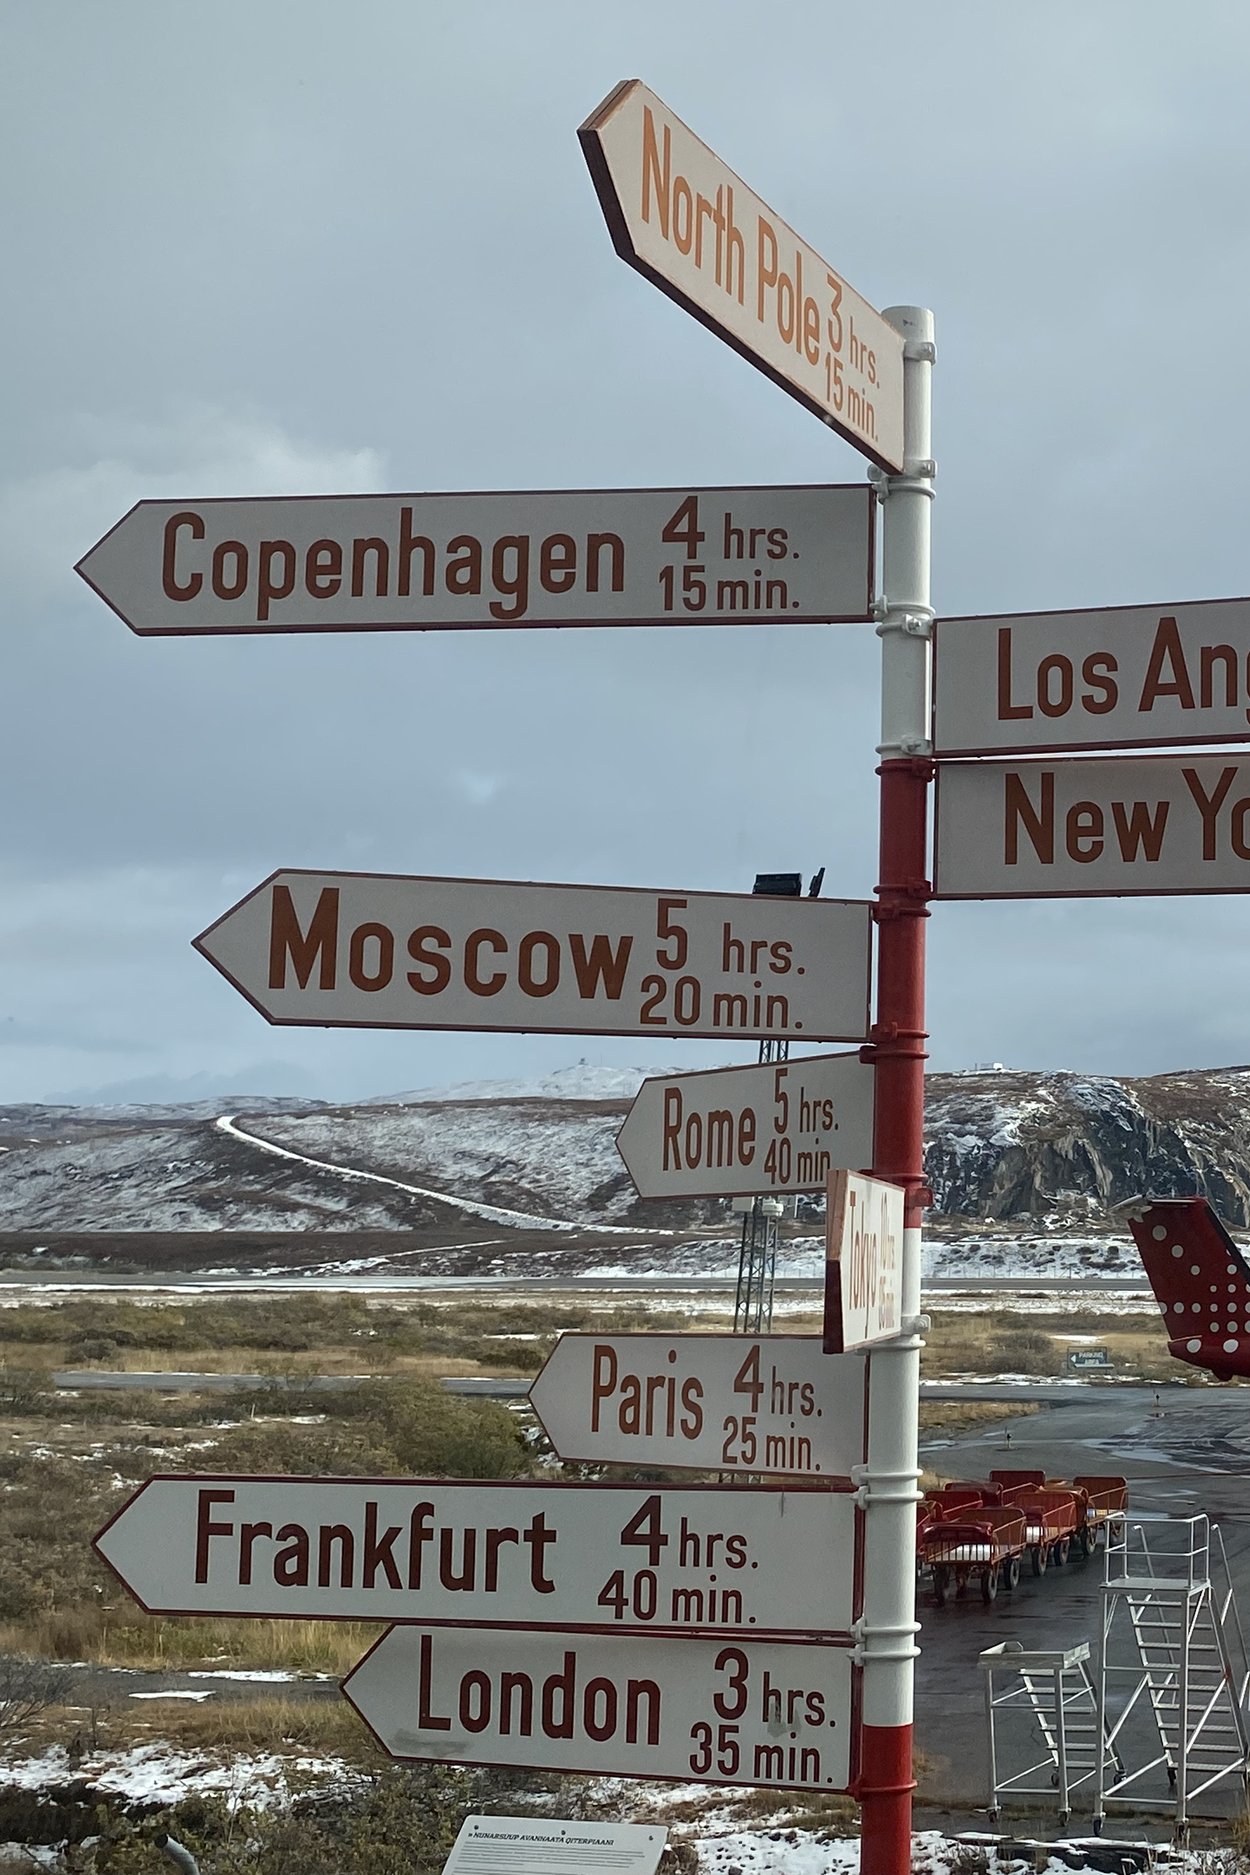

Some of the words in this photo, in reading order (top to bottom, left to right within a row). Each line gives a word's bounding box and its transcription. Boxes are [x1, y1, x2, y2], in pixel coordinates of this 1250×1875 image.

[641, 104, 745, 306] North
[757, 214, 820, 366] Pole
[826, 272, 844, 353] 3
[849, 315, 881, 389] hrs.
[823, 351, 844, 412] 15
[847, 384, 880, 443] min.
[162, 507, 625, 621] Copenhagen
[661, 495, 706, 560] 4
[723, 512, 800, 560] hrs.
[658, 564, 707, 611] 15
[716, 569, 800, 611] min.
[997, 627, 1119, 721] Los
[1004, 771, 1171, 865] New
[268, 884, 634, 1000] Moscow
[656, 898, 688, 971] 5
[722, 922, 806, 975] hrs.
[639, 974, 701, 1026] 20
[712, 980, 803, 1030] min.
[662, 1086, 756, 1172] Rome
[773, 1067, 788, 1134] 5
[799, 1086, 839, 1133] hrs.
[763, 1136, 791, 1185] 40
[849, 1190, 877, 1339] Tokyo
[591, 1344, 704, 1440] Paris
[733, 1344, 764, 1413] 4
[771, 1365, 822, 1417] hrs.
[722, 1415, 757, 1465] 25
[765, 1421, 821, 1471] min.
[195, 1489, 558, 1594] Frankfurt
[620, 1495, 669, 1567] 4
[679, 1517, 759, 1570] hrs.
[597, 1569, 658, 1621] 40
[671, 1574, 757, 1624] min.
[418, 1634, 661, 1746] London
[713, 1647, 749, 1721] 3
[762, 1671, 836, 1727] hrs.
[689, 1721, 740, 1776] 35
[753, 1732, 833, 1783] min.
[473, 1832, 520, 1841] NUNARSUUP
[520, 1834, 564, 1843] AVANNAATA
